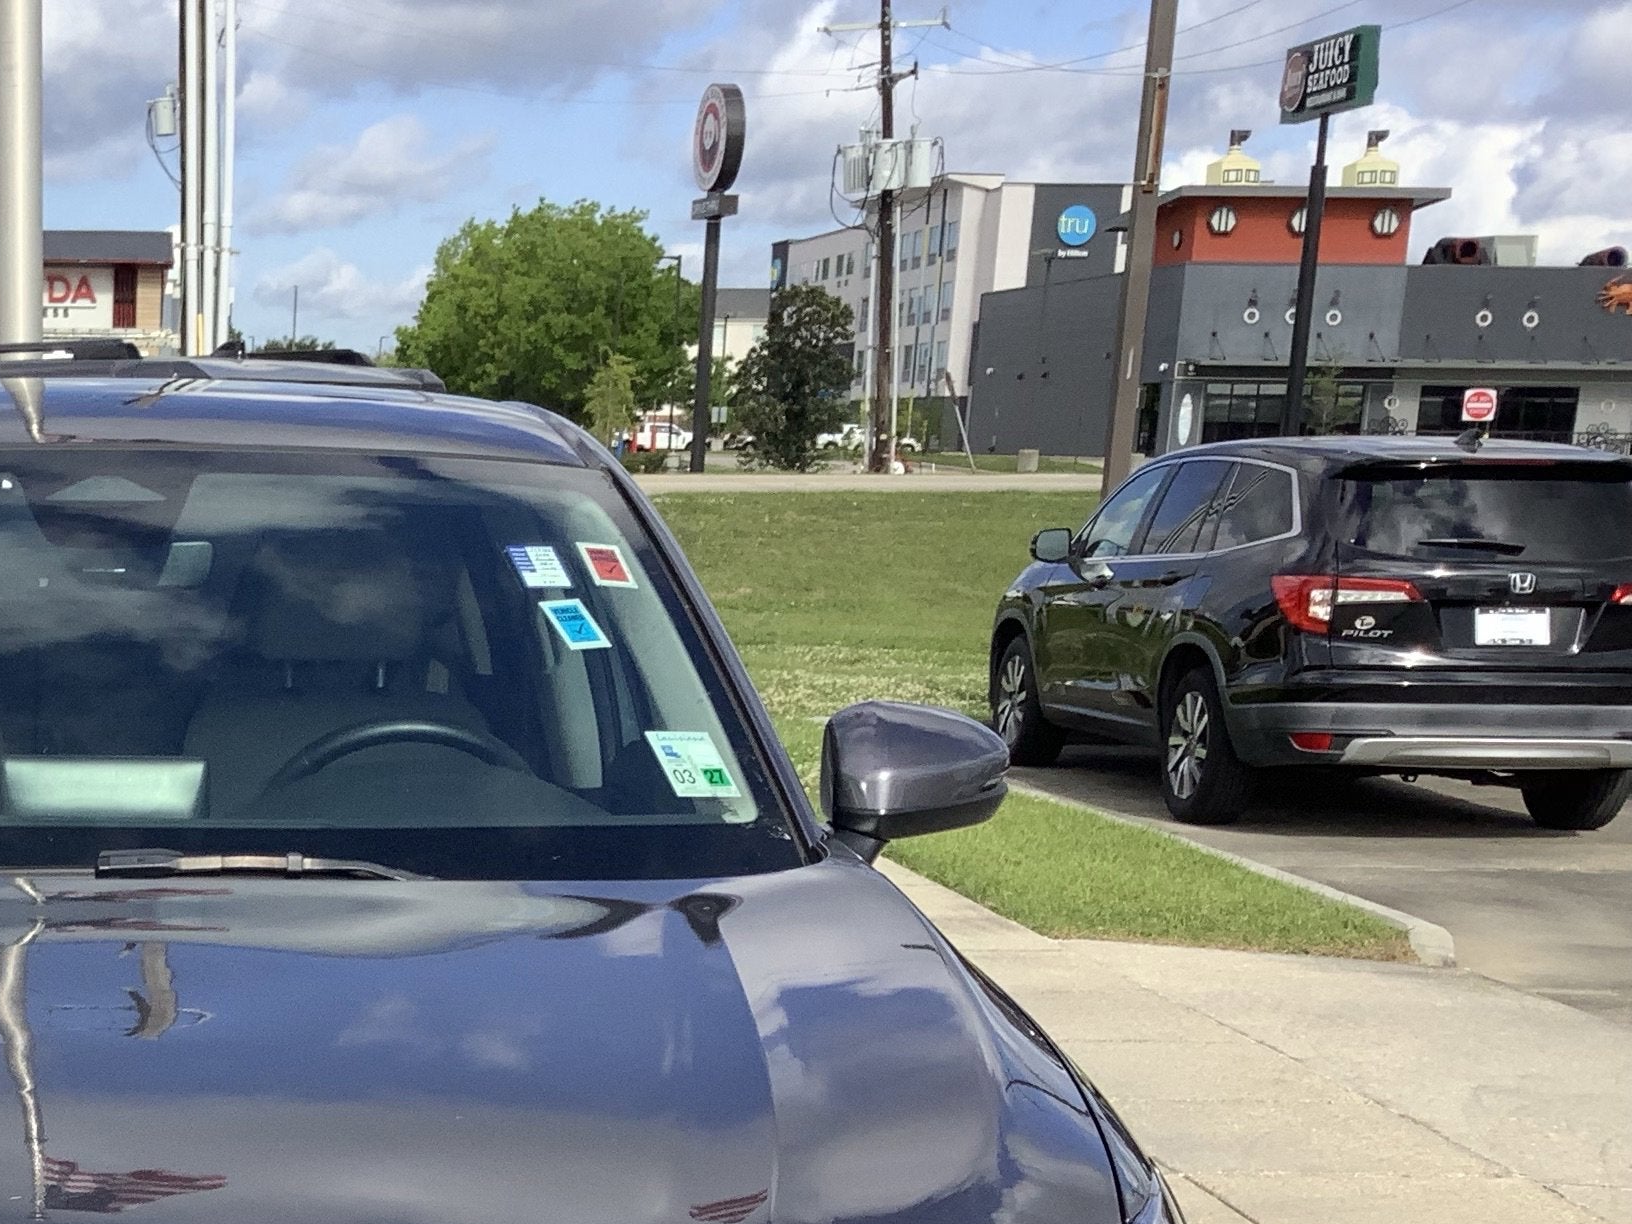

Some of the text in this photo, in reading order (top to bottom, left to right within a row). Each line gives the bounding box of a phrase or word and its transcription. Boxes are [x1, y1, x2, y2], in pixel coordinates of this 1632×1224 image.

[1309, 33, 1354, 73] JUICY
[1306, 64, 1350, 93] SEAFOOD
[1059, 214, 1089, 235] tru
[1341, 629, 1394, 638] PILOT
[673, 769, 725, 784] 03 27
